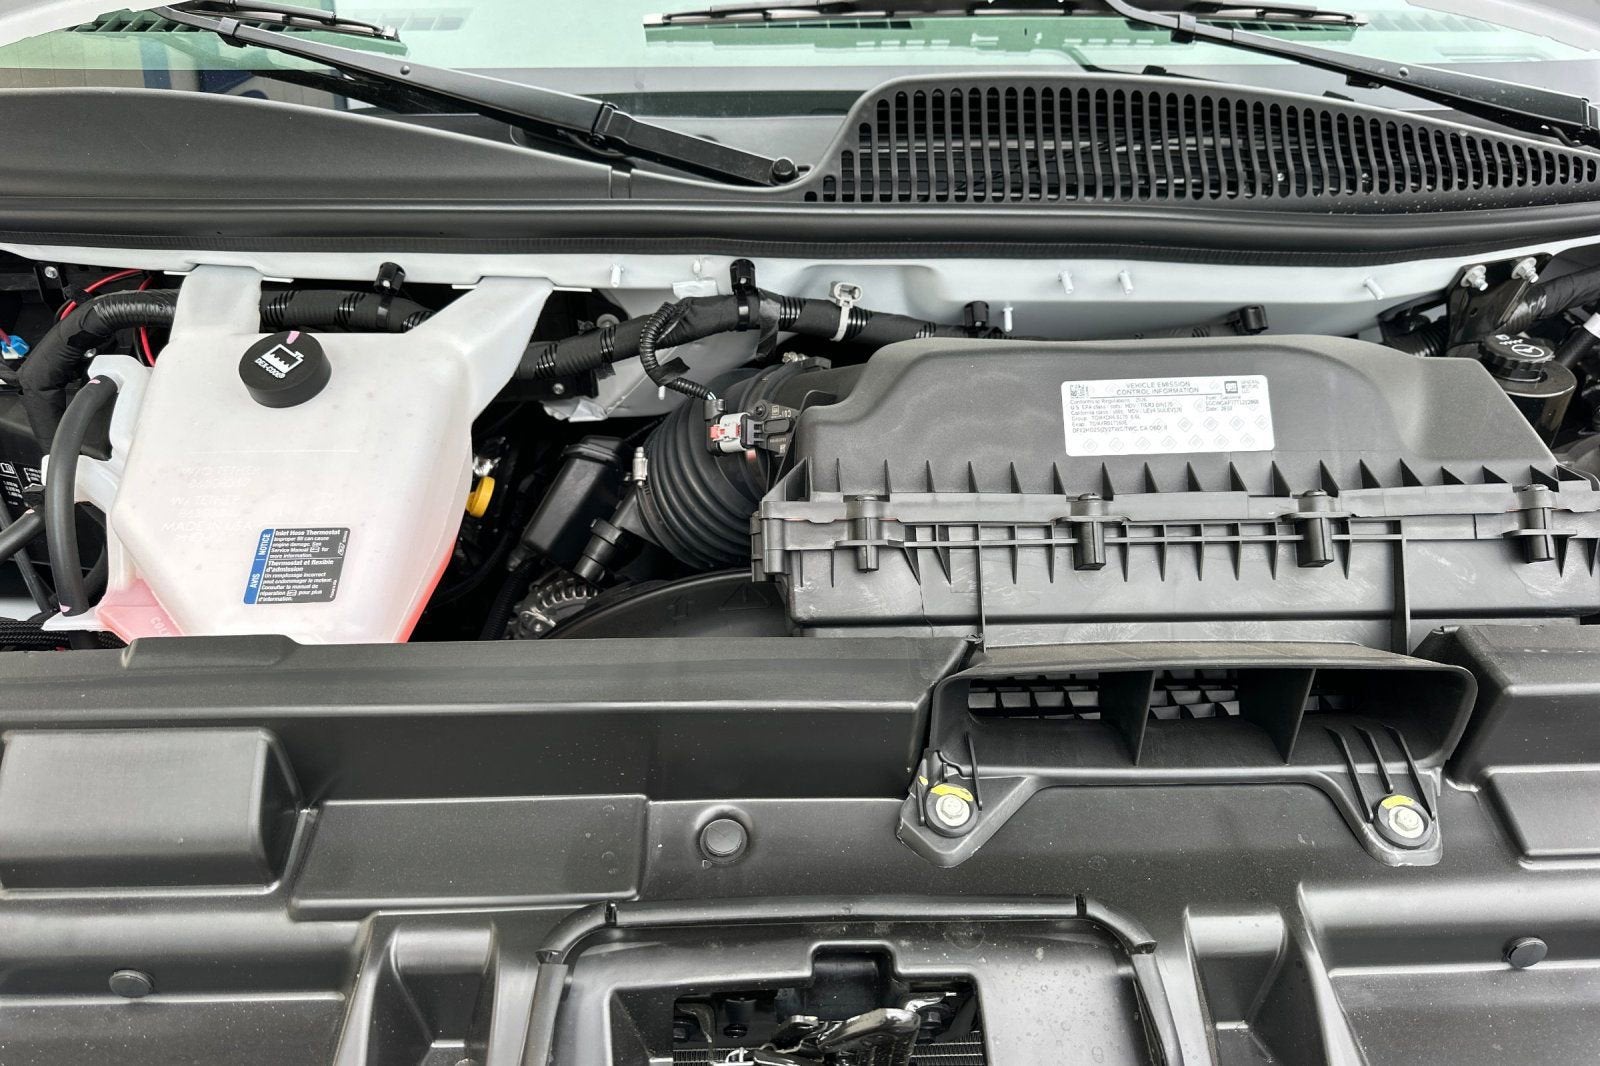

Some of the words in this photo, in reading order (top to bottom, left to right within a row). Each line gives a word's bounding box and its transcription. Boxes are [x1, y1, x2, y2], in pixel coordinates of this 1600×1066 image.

[1116, 388, 1150, 396] CONTROL
[1152, 386, 1199, 394] INFORMATION
[1126, 381, 1154, 389] VEHICLE
[1157, 380, 1190, 388] EMISSION
[258, 533, 271, 556] NOTICE
[249, 573, 260, 589] AVIS
